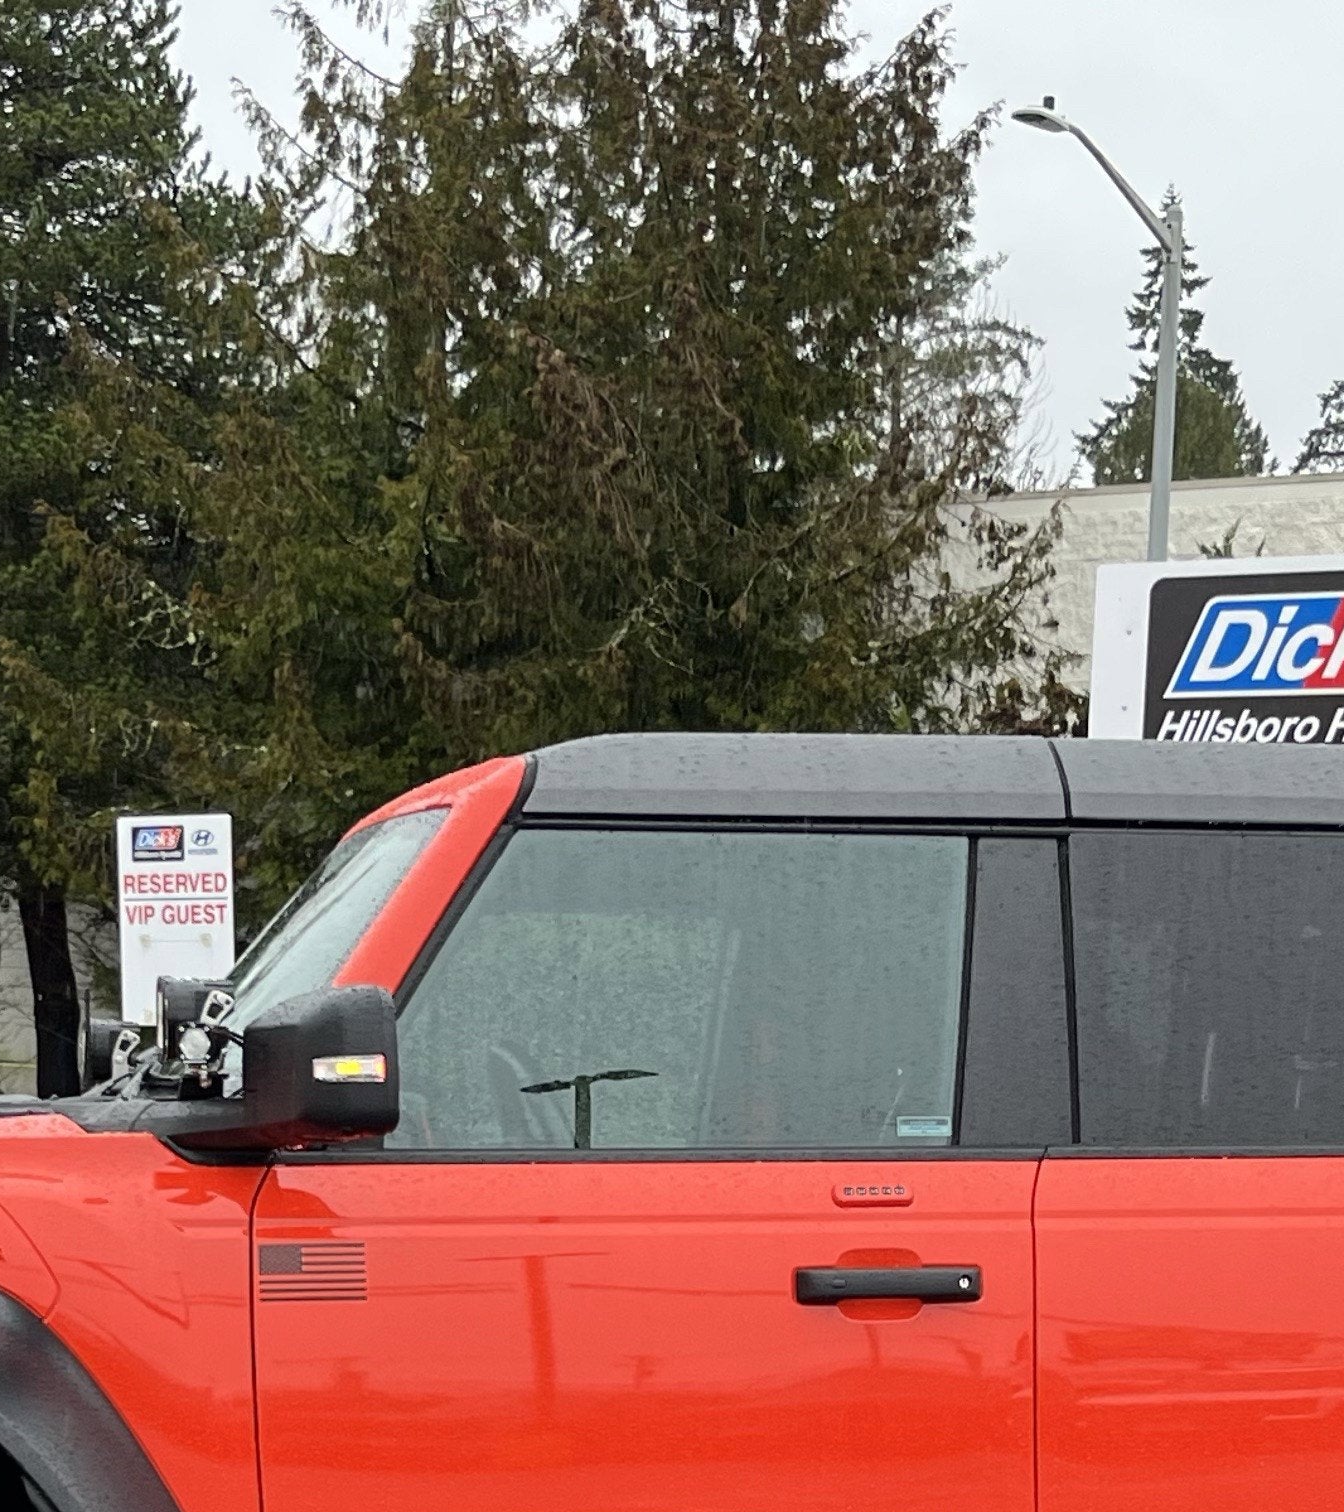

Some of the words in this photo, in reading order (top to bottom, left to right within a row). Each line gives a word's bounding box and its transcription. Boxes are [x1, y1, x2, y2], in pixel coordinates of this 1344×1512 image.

[1157, 708, 1321, 743] Hillsboro
[123, 872, 227, 894] RESERVED
[125, 905, 155, 925] VIP
[161, 904, 227, 924] GUEST
